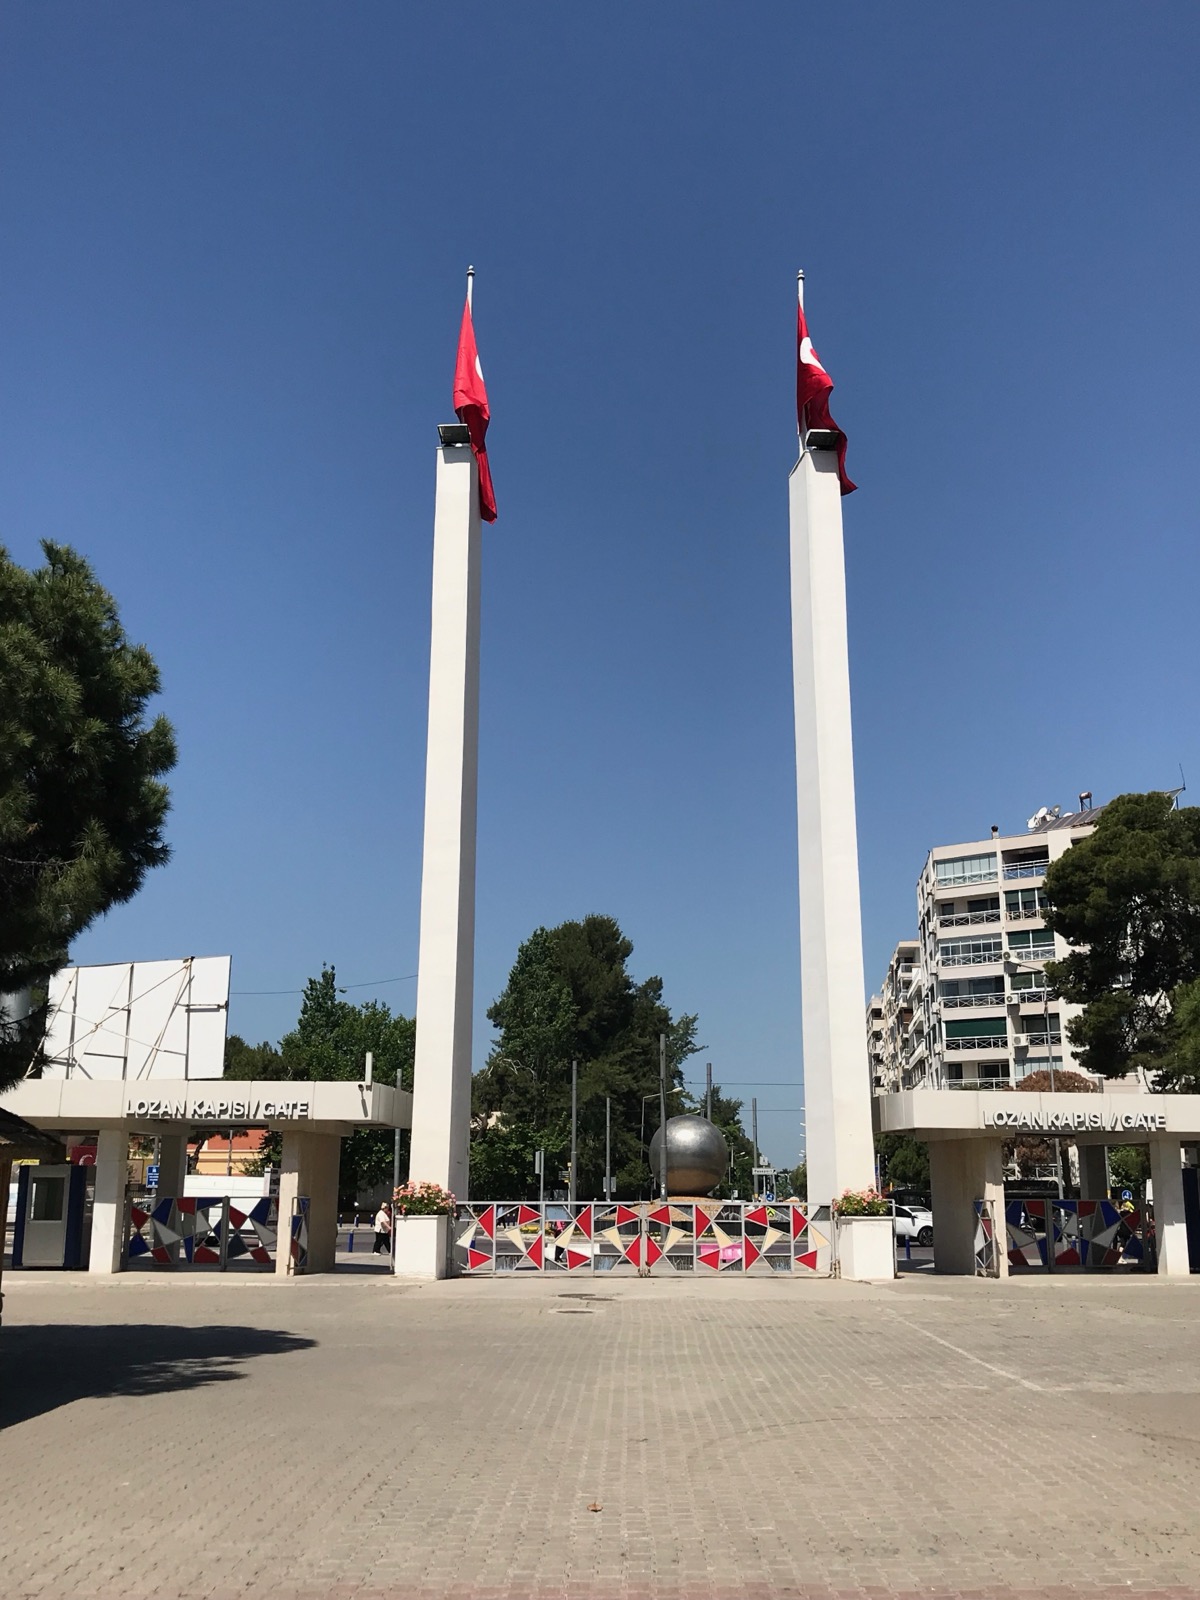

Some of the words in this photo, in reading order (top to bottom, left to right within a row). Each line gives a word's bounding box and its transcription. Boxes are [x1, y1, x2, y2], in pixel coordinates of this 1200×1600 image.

[126, 1100, 187, 1116] LOZAN
[191, 1100, 249, 1116] KAPISI
[262, 1101, 310, 1117] GATE
[983, 1111, 1044, 1127] LOZAN
[1049, 1112, 1105, 1128] KAPISI
[1121, 1113, 1167, 1129] GATE
